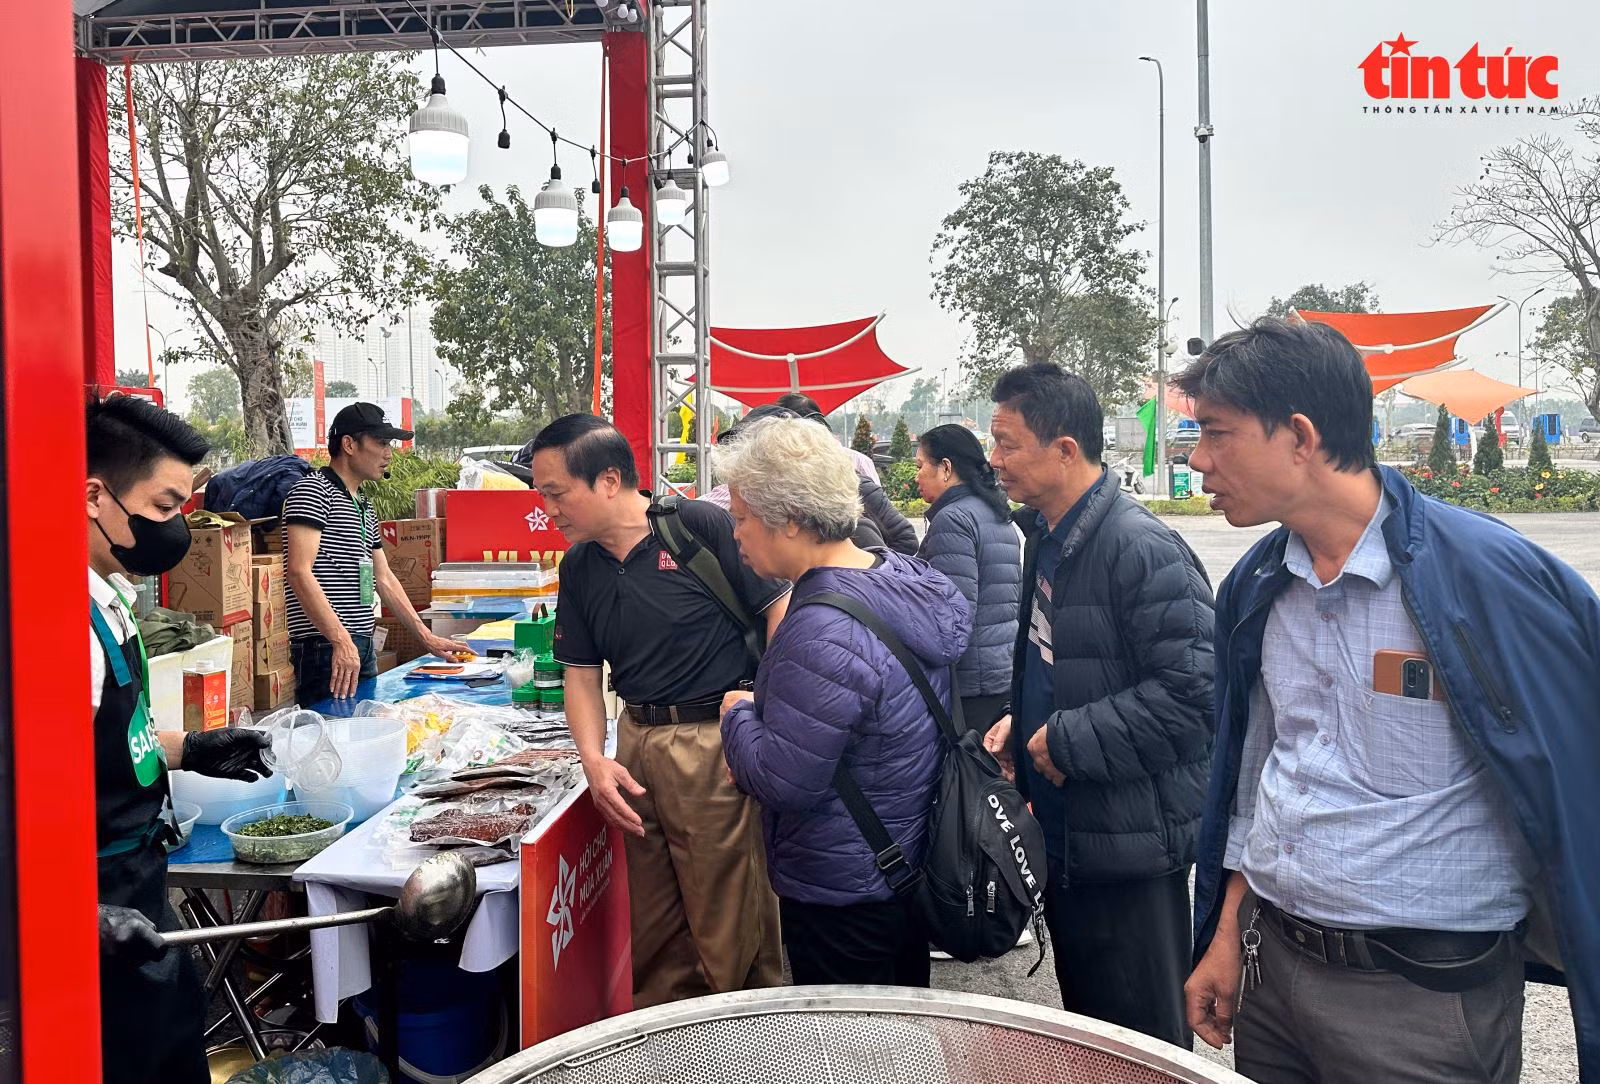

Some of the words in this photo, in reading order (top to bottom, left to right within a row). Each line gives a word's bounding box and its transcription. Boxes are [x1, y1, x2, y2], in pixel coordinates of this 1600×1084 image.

[596, 846, 613, 884] XUÂN
[987, 794, 1015, 833] OVE
[1009, 834, 1037, 889] LOVE
